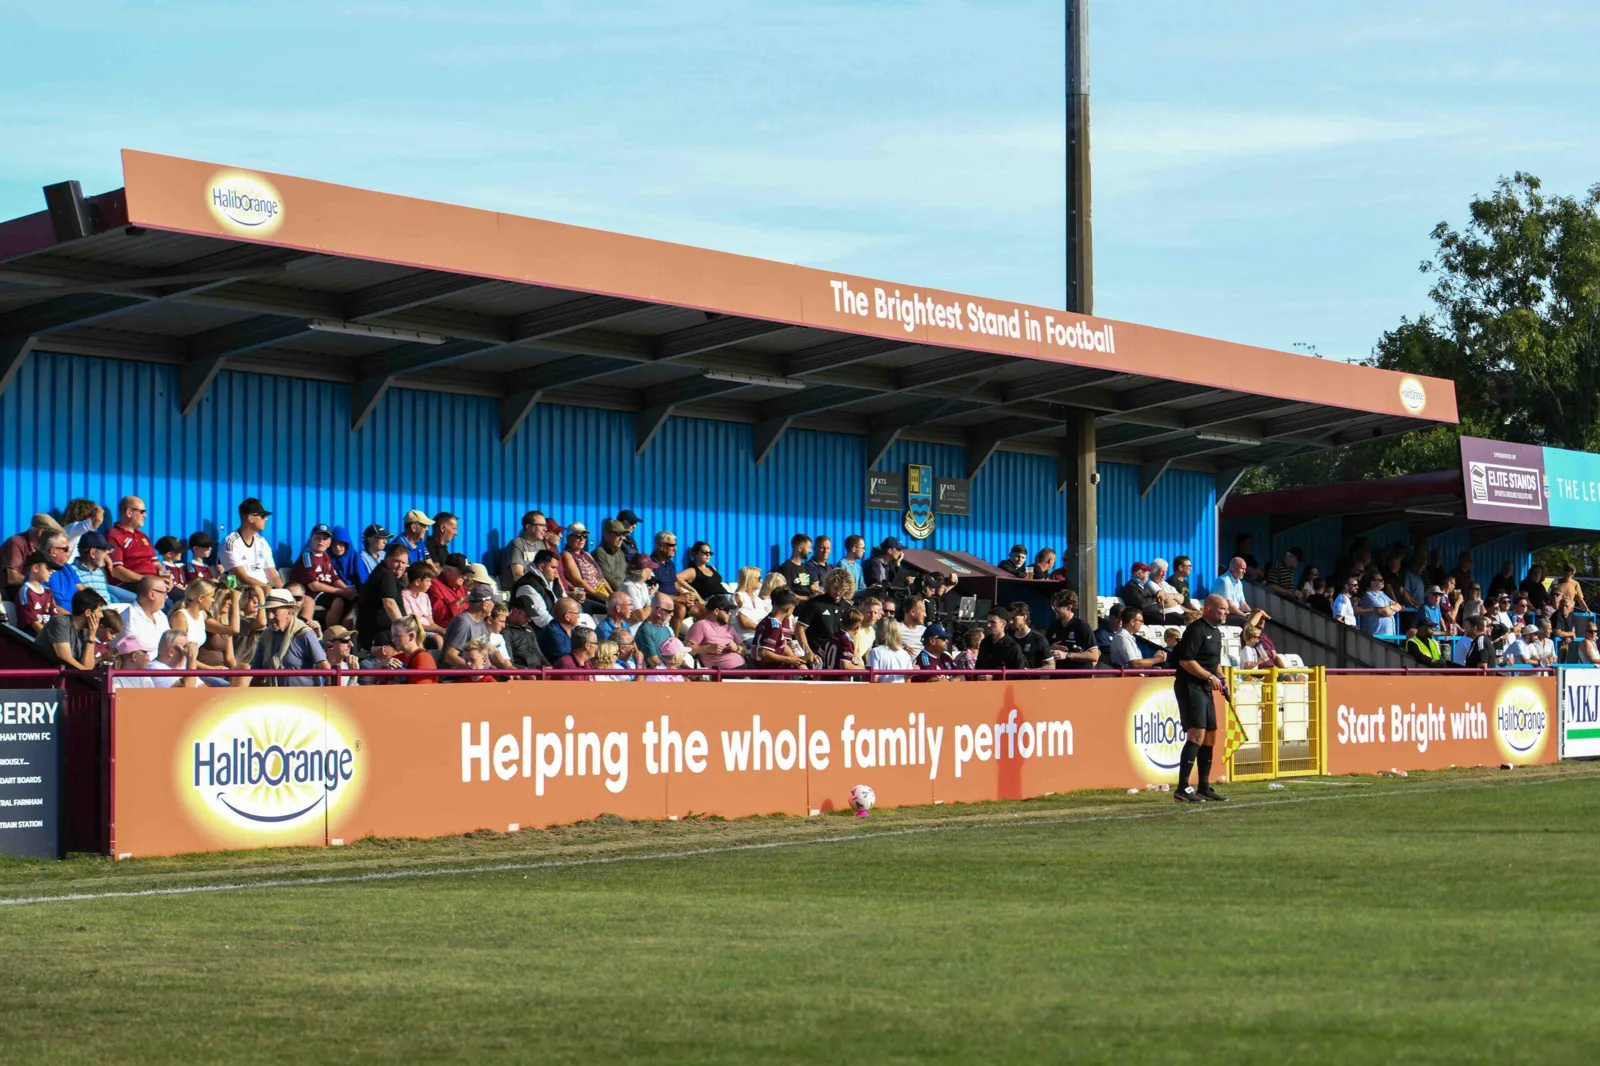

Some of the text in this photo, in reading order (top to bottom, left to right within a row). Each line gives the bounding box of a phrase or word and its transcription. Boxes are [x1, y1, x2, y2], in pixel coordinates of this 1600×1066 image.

[830, 280, 1116, 354] The Brightest Stand in Football
[1488, 470, 1537, 490] ELITE STANDS
[1556, 478, 1580, 500] THE
[0, 701, 59, 725] ERRY
[18, 732, 40, 741] TOWN
[41, 732, 51, 741] FC
[1337, 702, 1488, 753] Start Bright with
[461, 709, 1073, 796] Helping the whole family perform
[13, 798, 43, 806] FARNHAM
[18, 820, 43, 828] STATION
